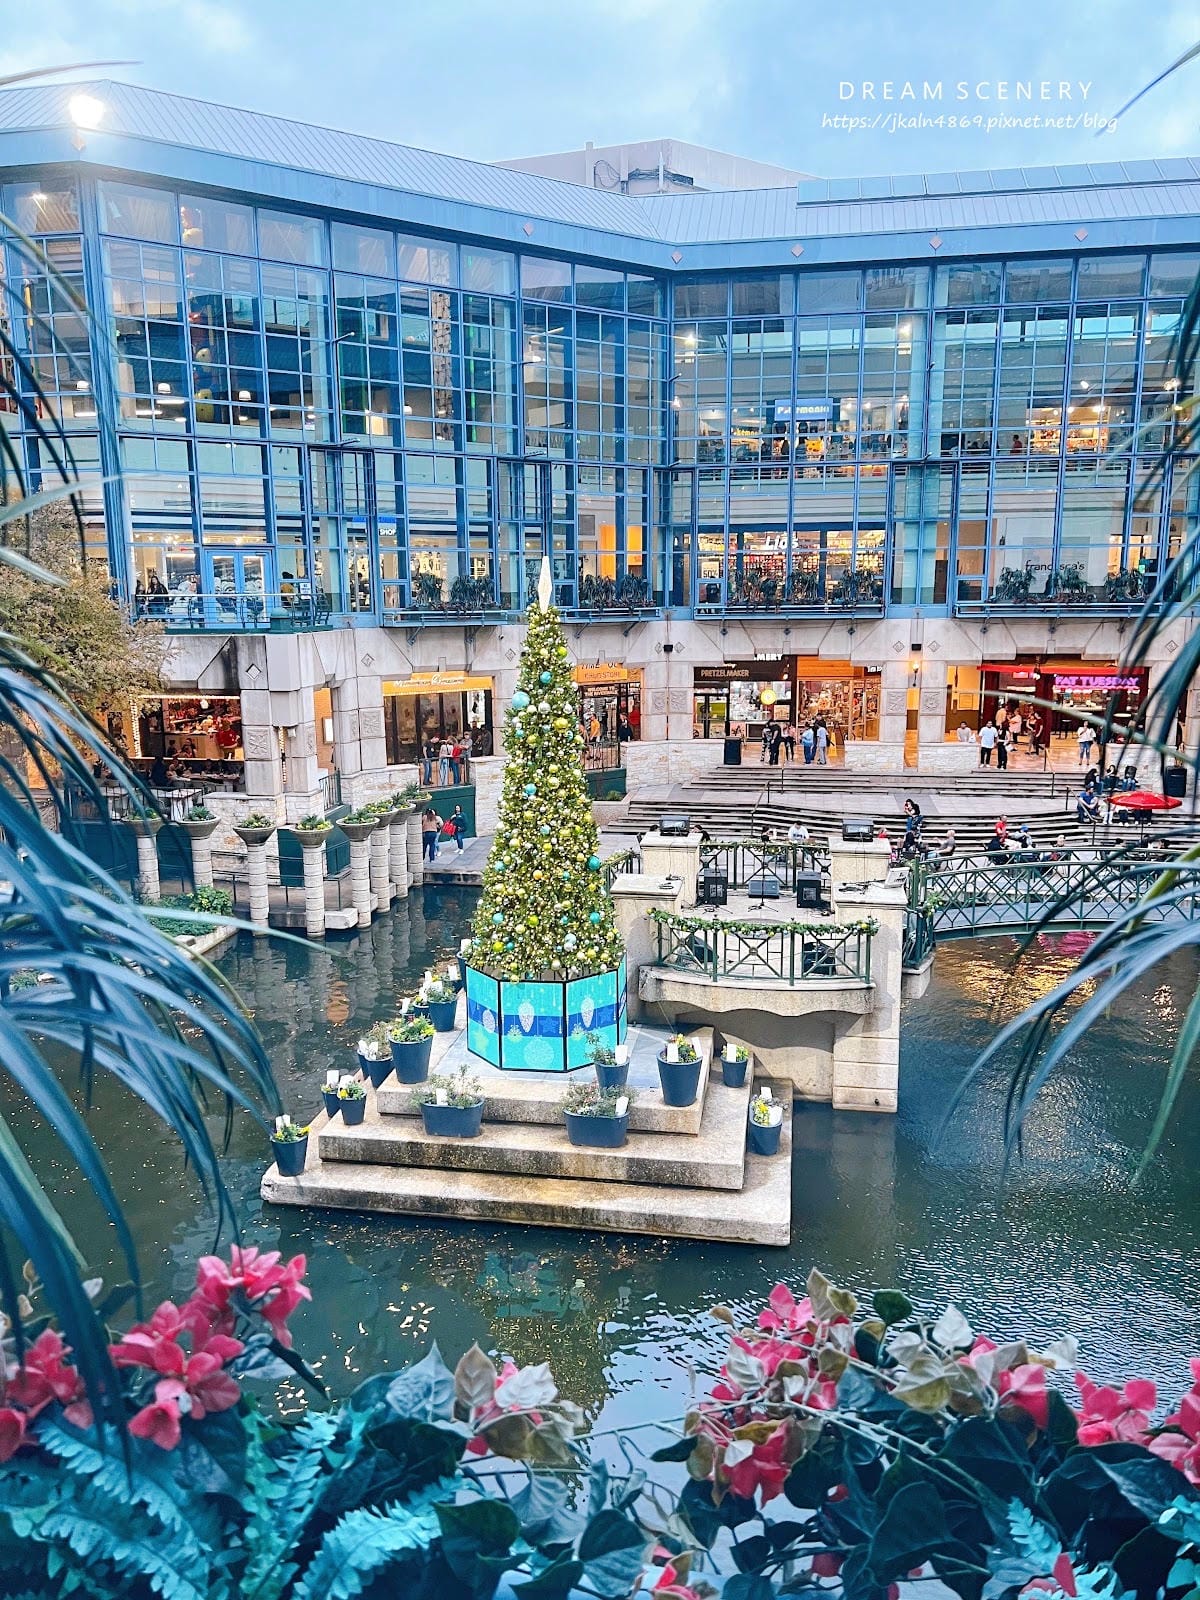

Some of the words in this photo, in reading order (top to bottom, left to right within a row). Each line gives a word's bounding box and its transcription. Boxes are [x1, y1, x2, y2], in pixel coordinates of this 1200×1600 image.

[1024, 559, 1085, 571] francsca's
[753, 653, 783, 661] MERY
[700, 669, 750, 677] PRETZELMAKER
[1054, 676, 1077, 686] FAT
[1081, 676, 1140, 687] TUESDAY
